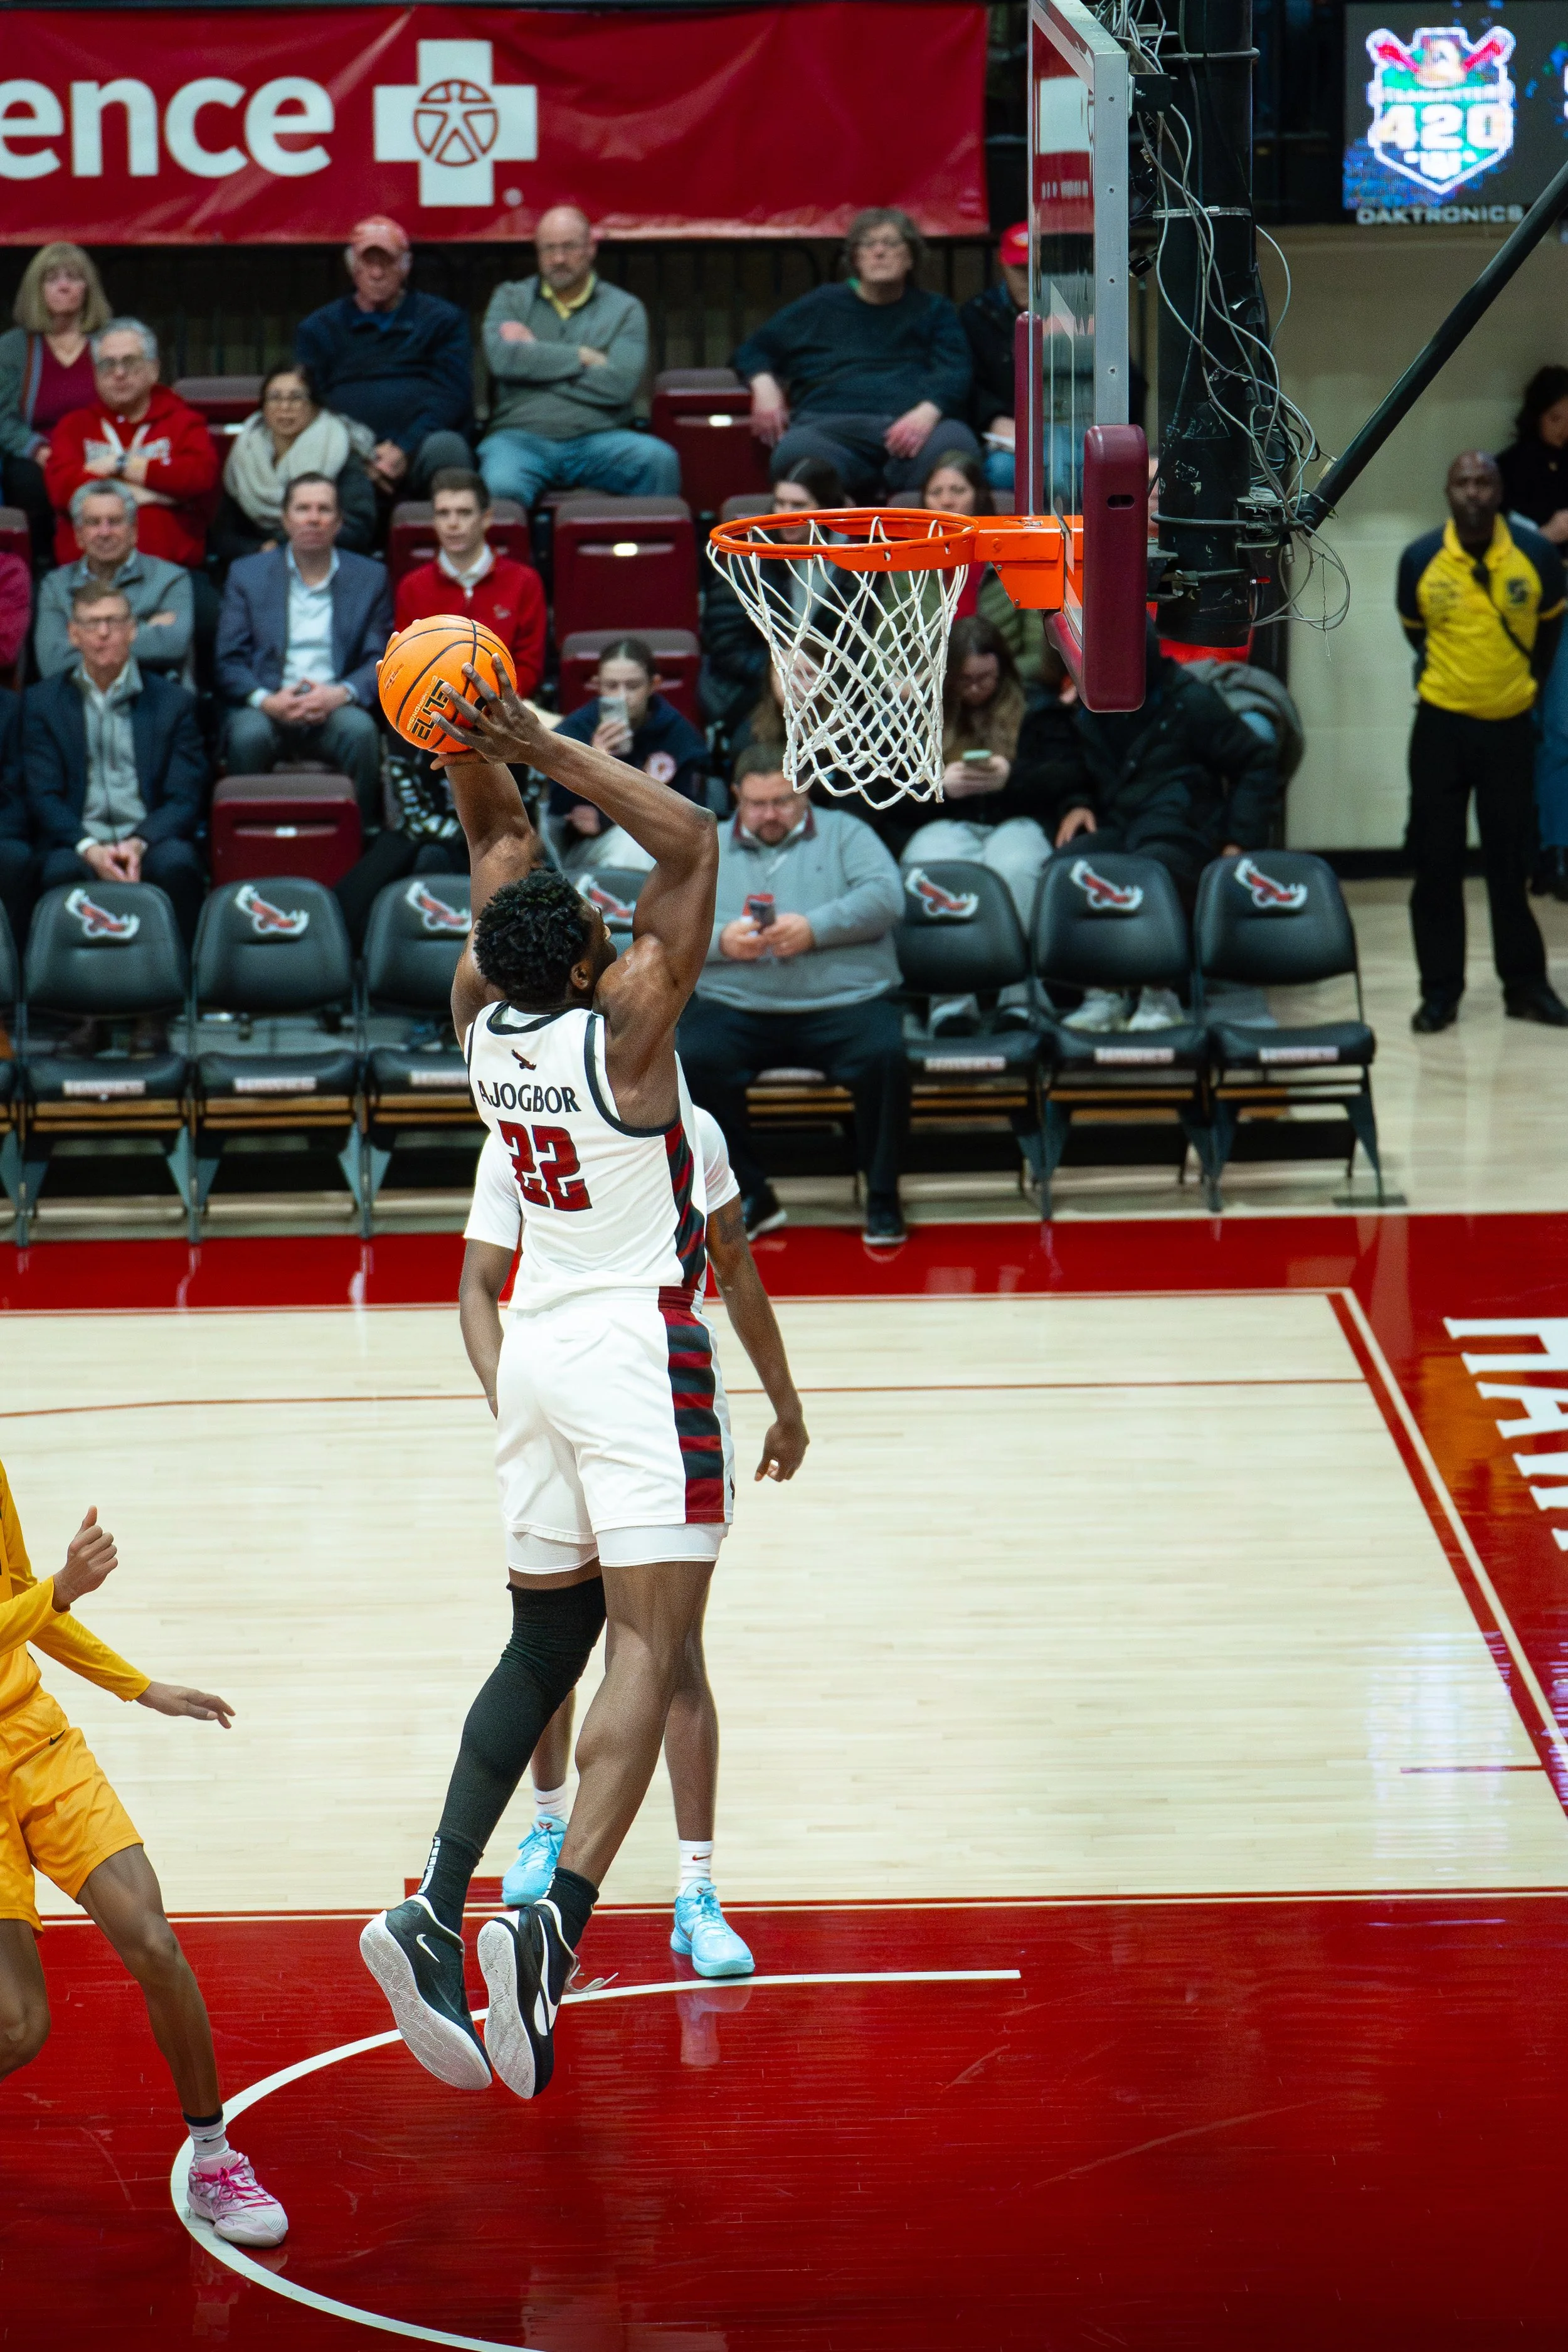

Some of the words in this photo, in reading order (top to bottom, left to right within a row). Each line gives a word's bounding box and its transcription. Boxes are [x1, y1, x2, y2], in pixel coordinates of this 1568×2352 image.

[0, 77, 334, 180] ence
[1369, 104, 1513, 149] 420
[477, 1080, 582, 1113] AJOGBOR
[496, 1118, 593, 1212] 22
